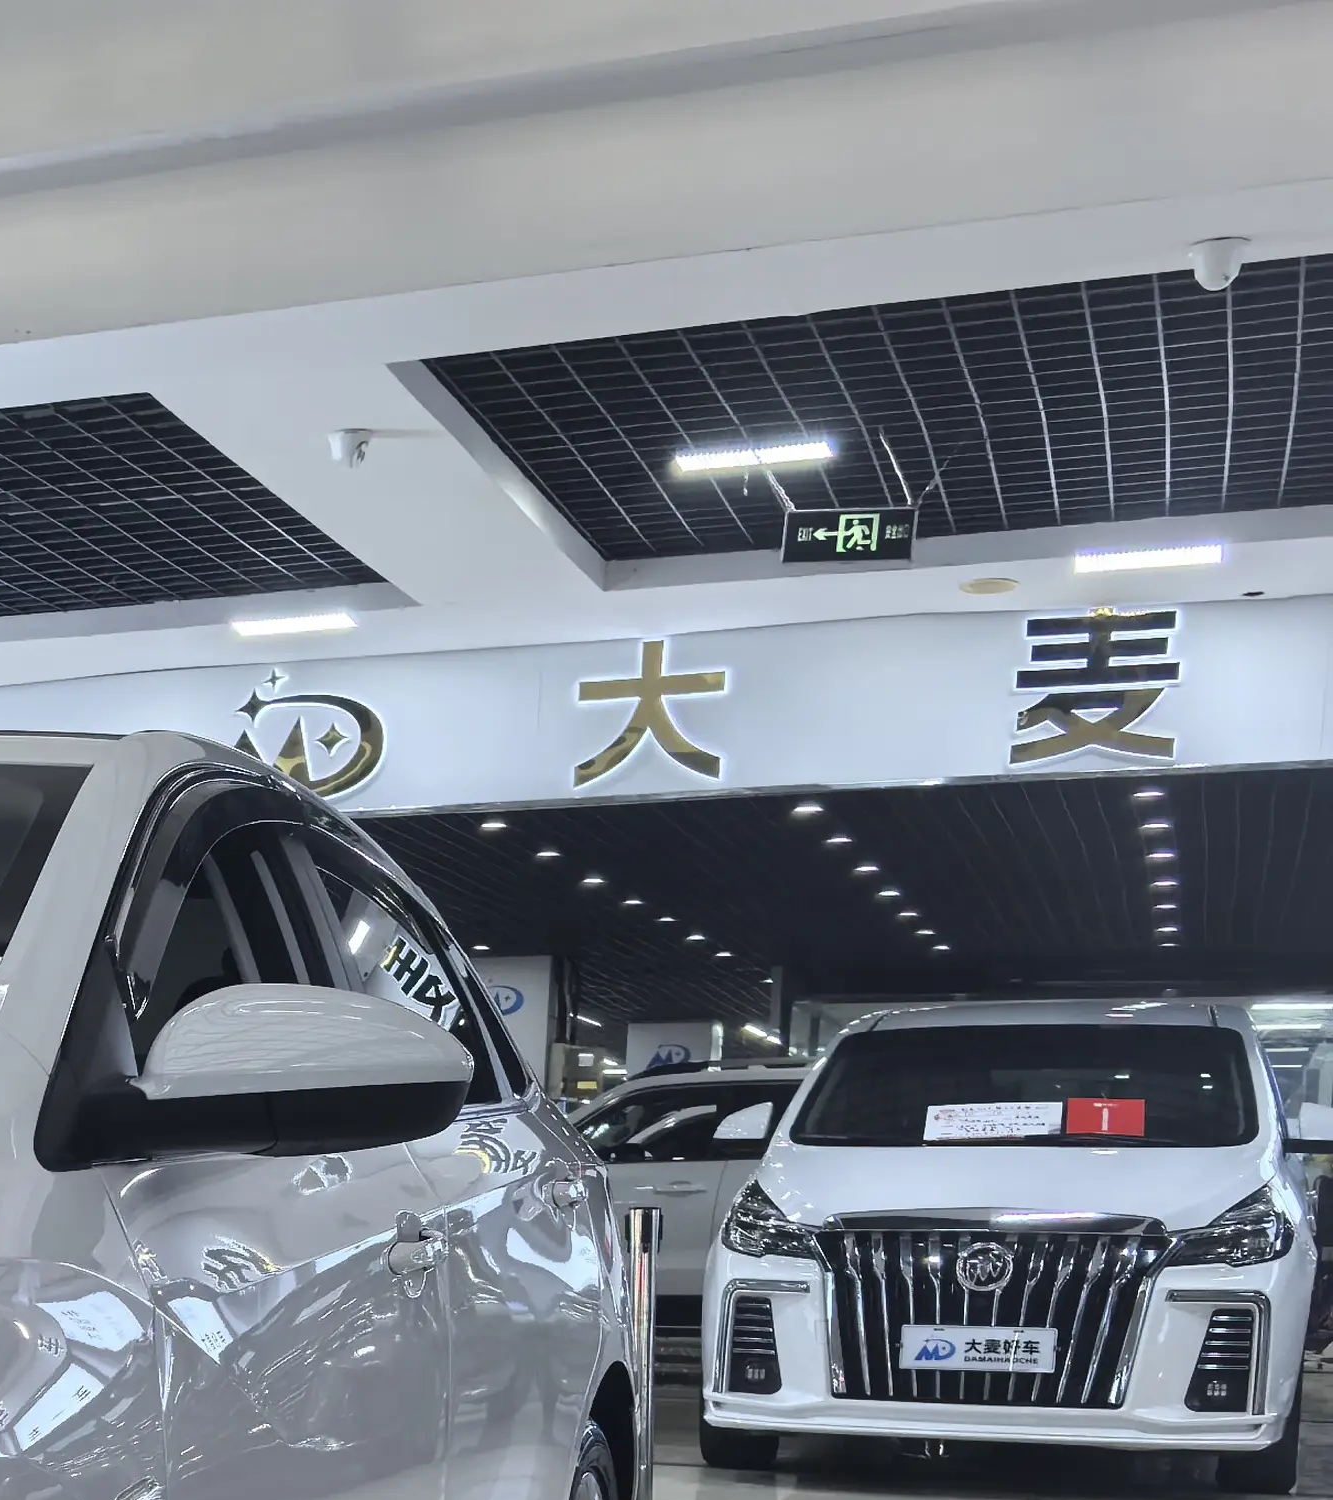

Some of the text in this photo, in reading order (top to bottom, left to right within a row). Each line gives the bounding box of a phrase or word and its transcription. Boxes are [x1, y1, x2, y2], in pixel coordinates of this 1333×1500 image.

[797, 527, 814, 542] EXIT
[573, 608, 1181, 788] 大麦
[963, 1338, 1041, 1355] 大麦好车
